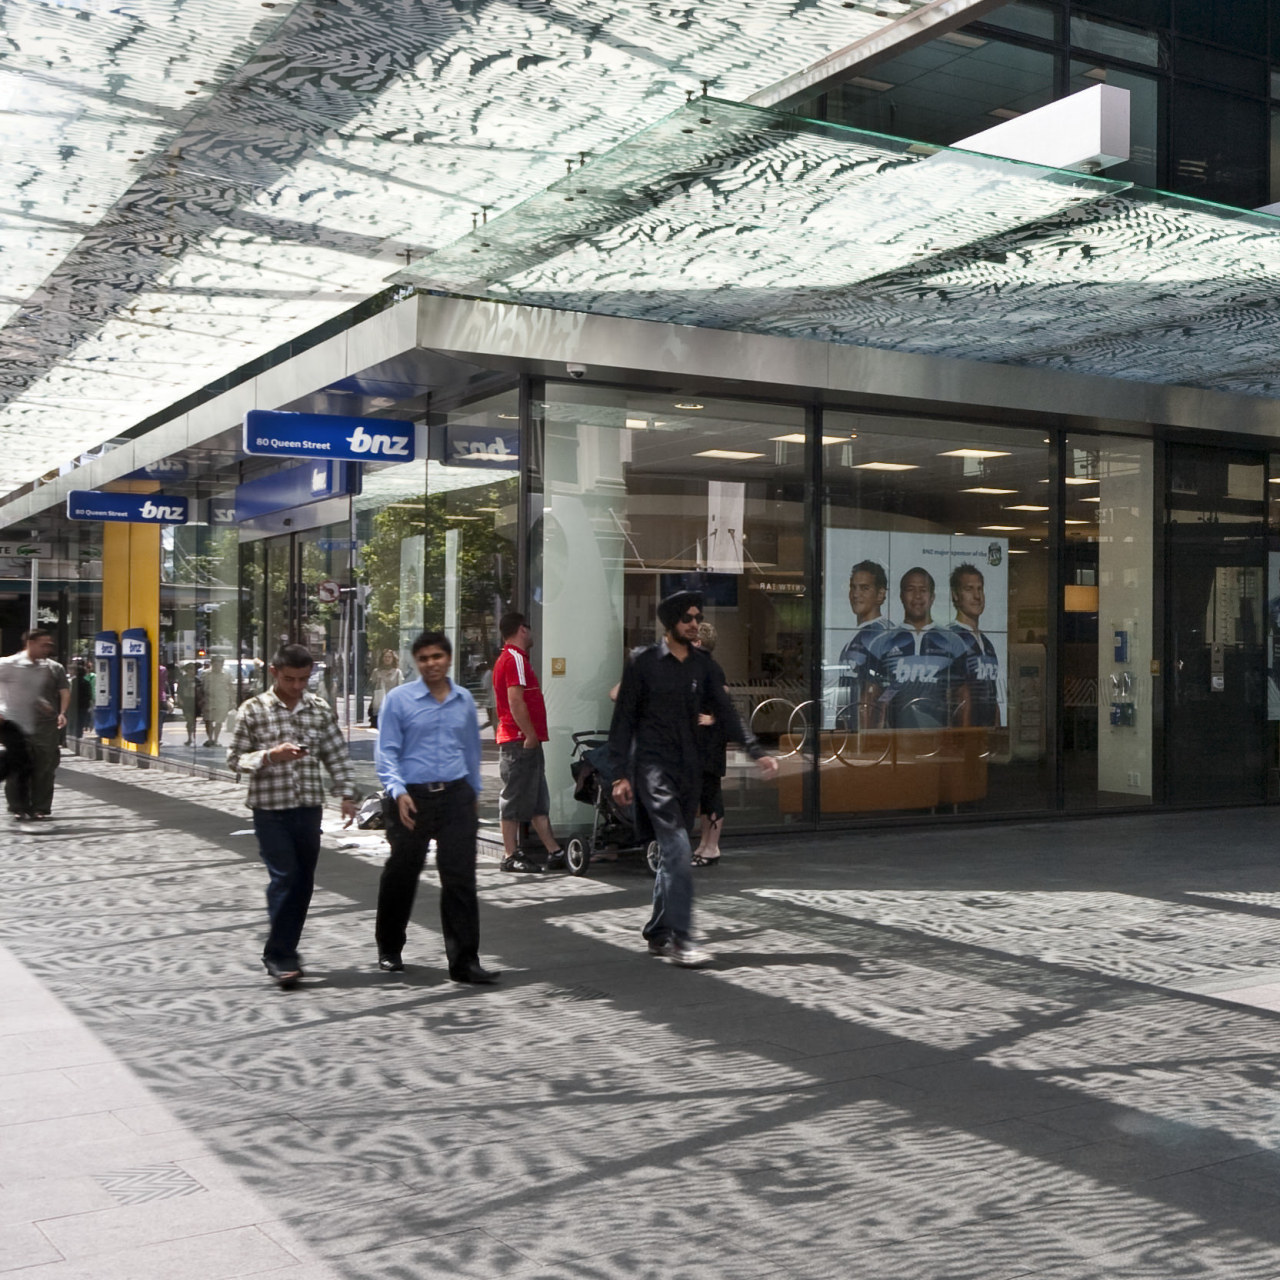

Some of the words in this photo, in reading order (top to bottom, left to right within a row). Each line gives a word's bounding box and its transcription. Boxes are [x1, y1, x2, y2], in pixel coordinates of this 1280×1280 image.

[256, 438, 269, 446] 80
[271, 438, 301, 449] Queen
[302, 440, 331, 450] Street
[346, 426, 409, 456] bnz
[86, 509, 107, 517] Queen
[138, 501, 184, 520] bnz
[101, 642, 113, 654] bnz
[129, 641, 142, 653] bnz
[892, 657, 941, 683] bnz
